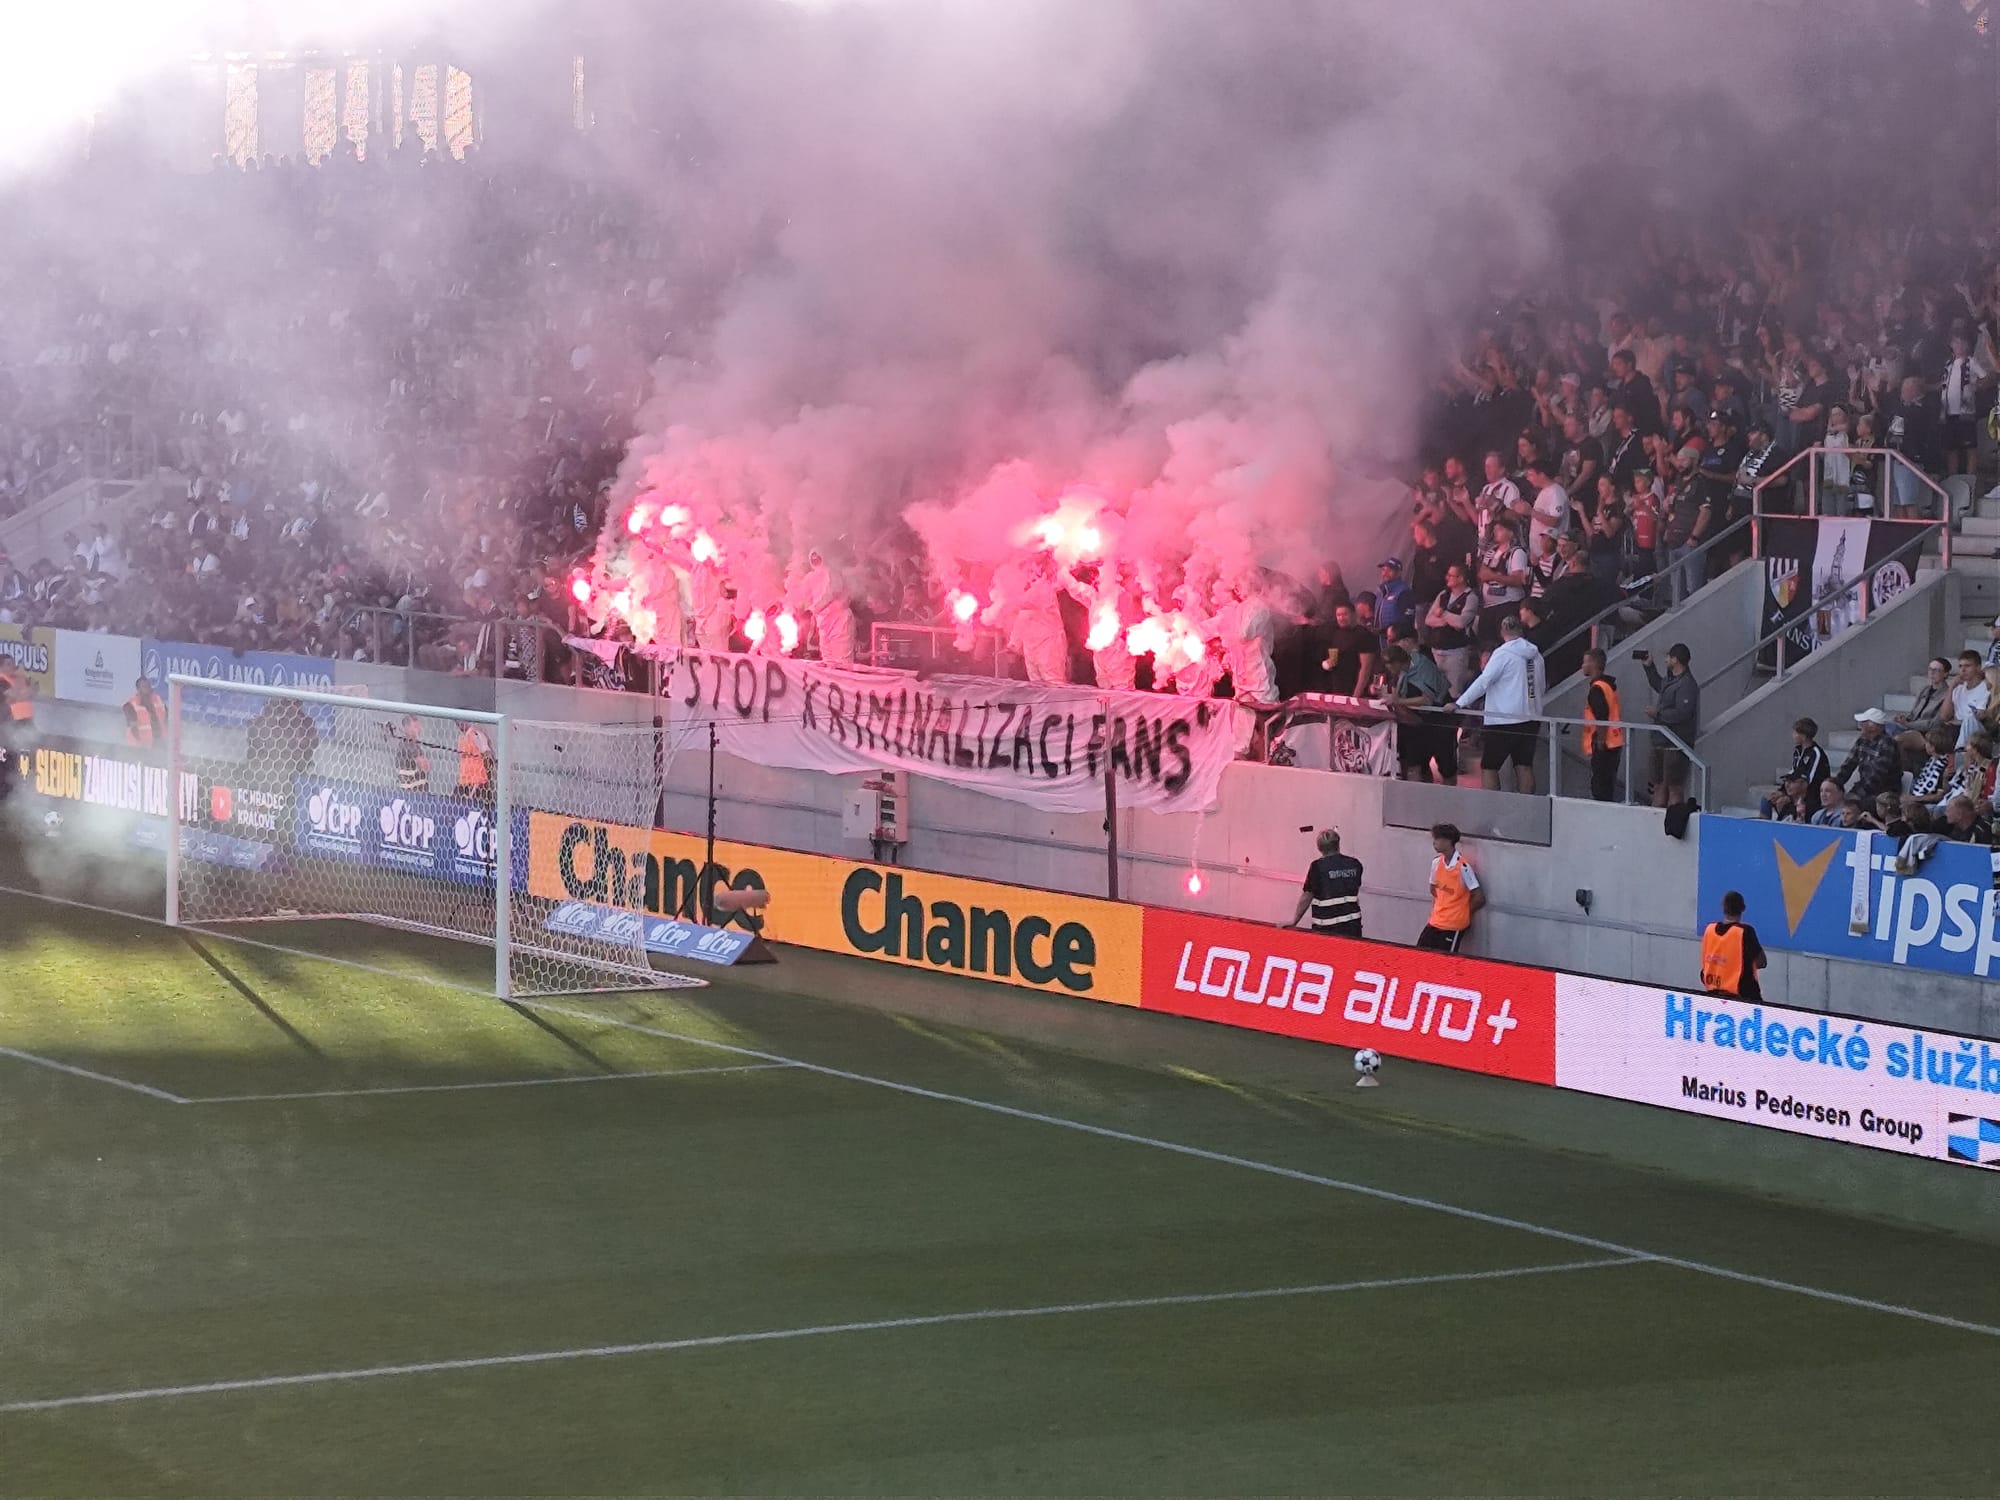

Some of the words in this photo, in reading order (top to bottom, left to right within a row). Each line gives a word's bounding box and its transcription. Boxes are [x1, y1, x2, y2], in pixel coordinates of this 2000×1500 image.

[36, 748, 82, 800] SLEDUJ
[559, 822, 767, 931] Chance
[841, 867, 1096, 991] Chance
[1664, 992, 1870, 1071] Hradecké
[1681, 1075, 1747, 1108] Marius
[1755, 1089, 1851, 1126] Pedersen
[1859, 1108, 1923, 1144] Group
